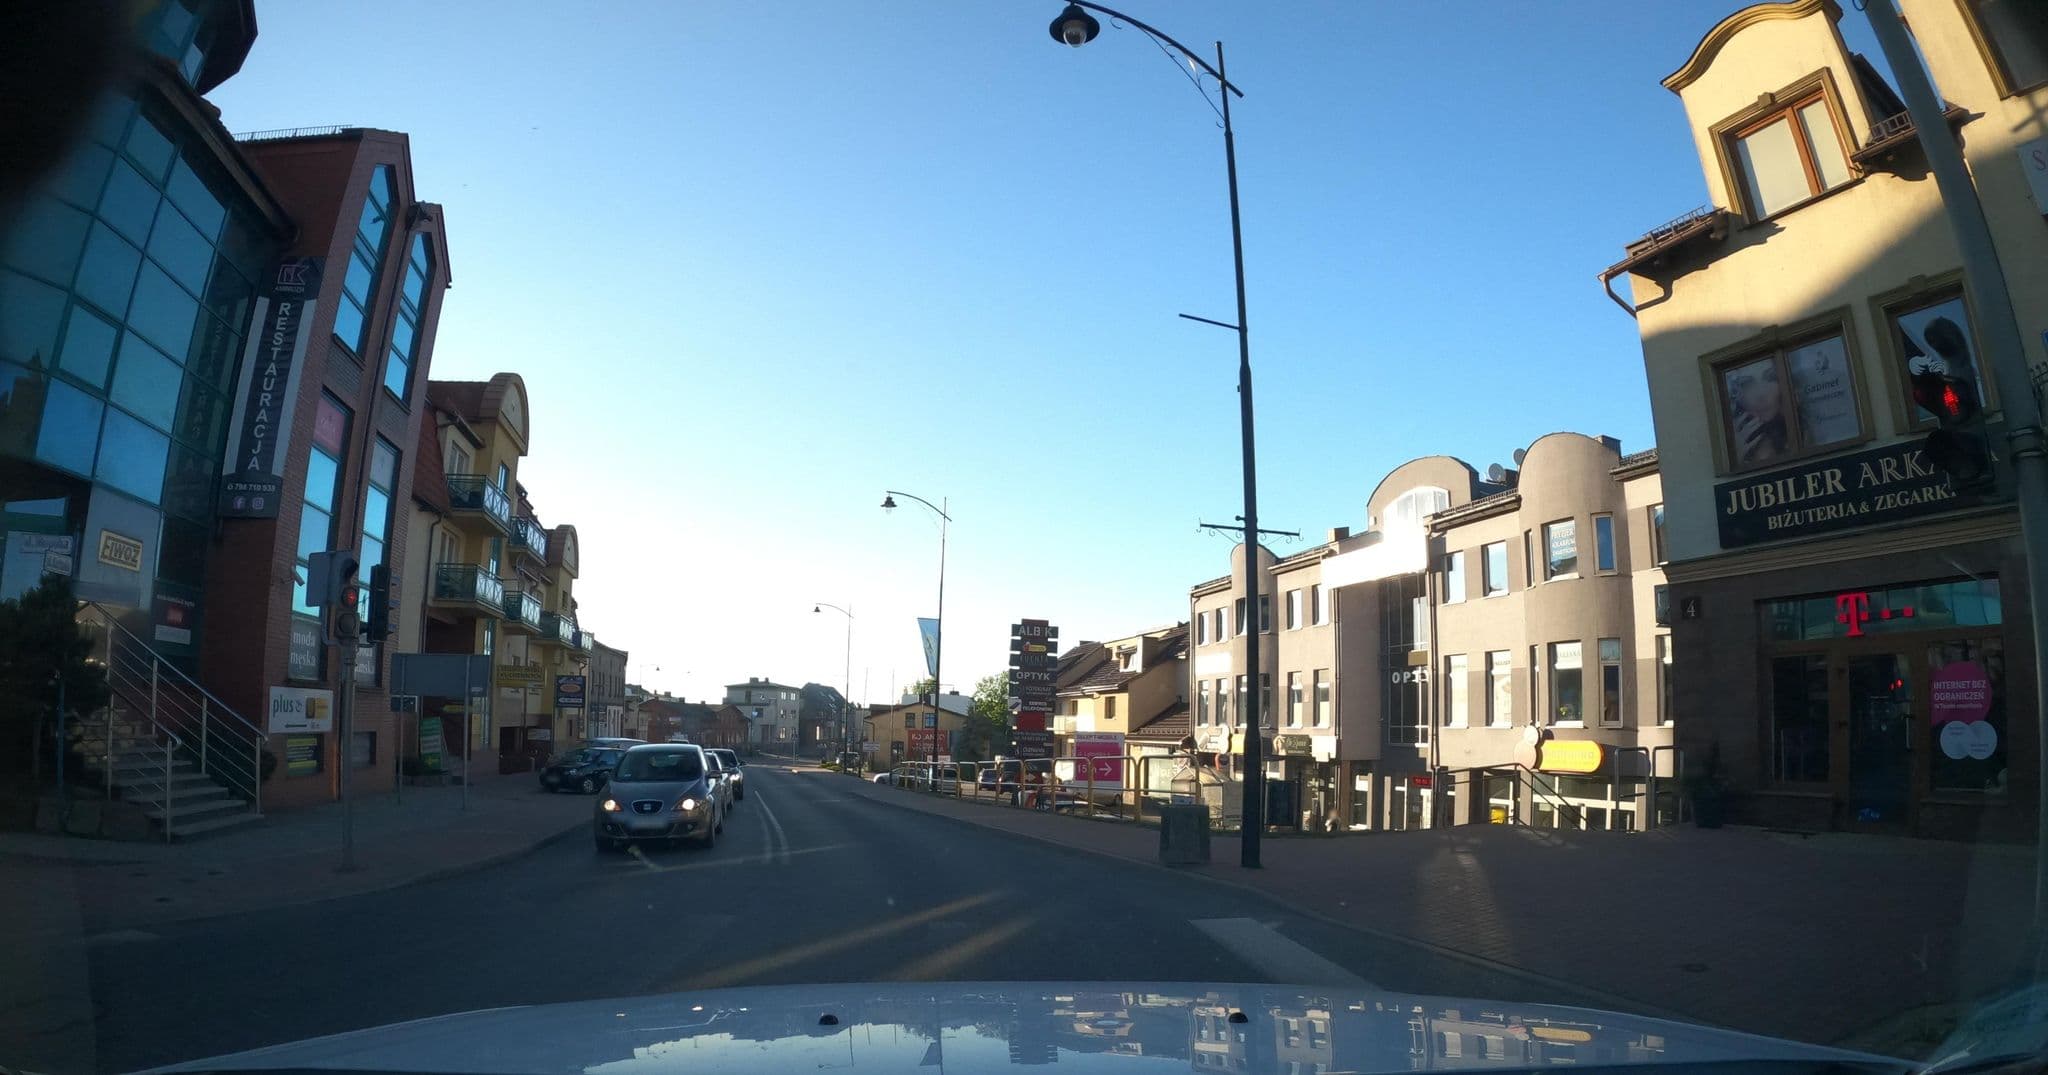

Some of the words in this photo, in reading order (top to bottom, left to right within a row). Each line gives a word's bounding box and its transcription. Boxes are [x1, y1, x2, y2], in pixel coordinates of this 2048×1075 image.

[247, 301, 292, 472] RESTAURACJA
[1726, 468, 1847, 515] JUBILER
[1767, 501, 1857, 530] BIŻUTERIA
[1859, 501, 1871, 513] &
[1687, 599, 1696, 617] 4
[1836, 592, 1869, 638] T
[292, 632, 316, 647] moda
[1016, 671, 1050, 681] OPTYK
[1933, 680, 1970, 689] INTERNET
[273, 694, 294, 718] plus
[1934, 690, 1985, 701] OGRANICZEŃ
